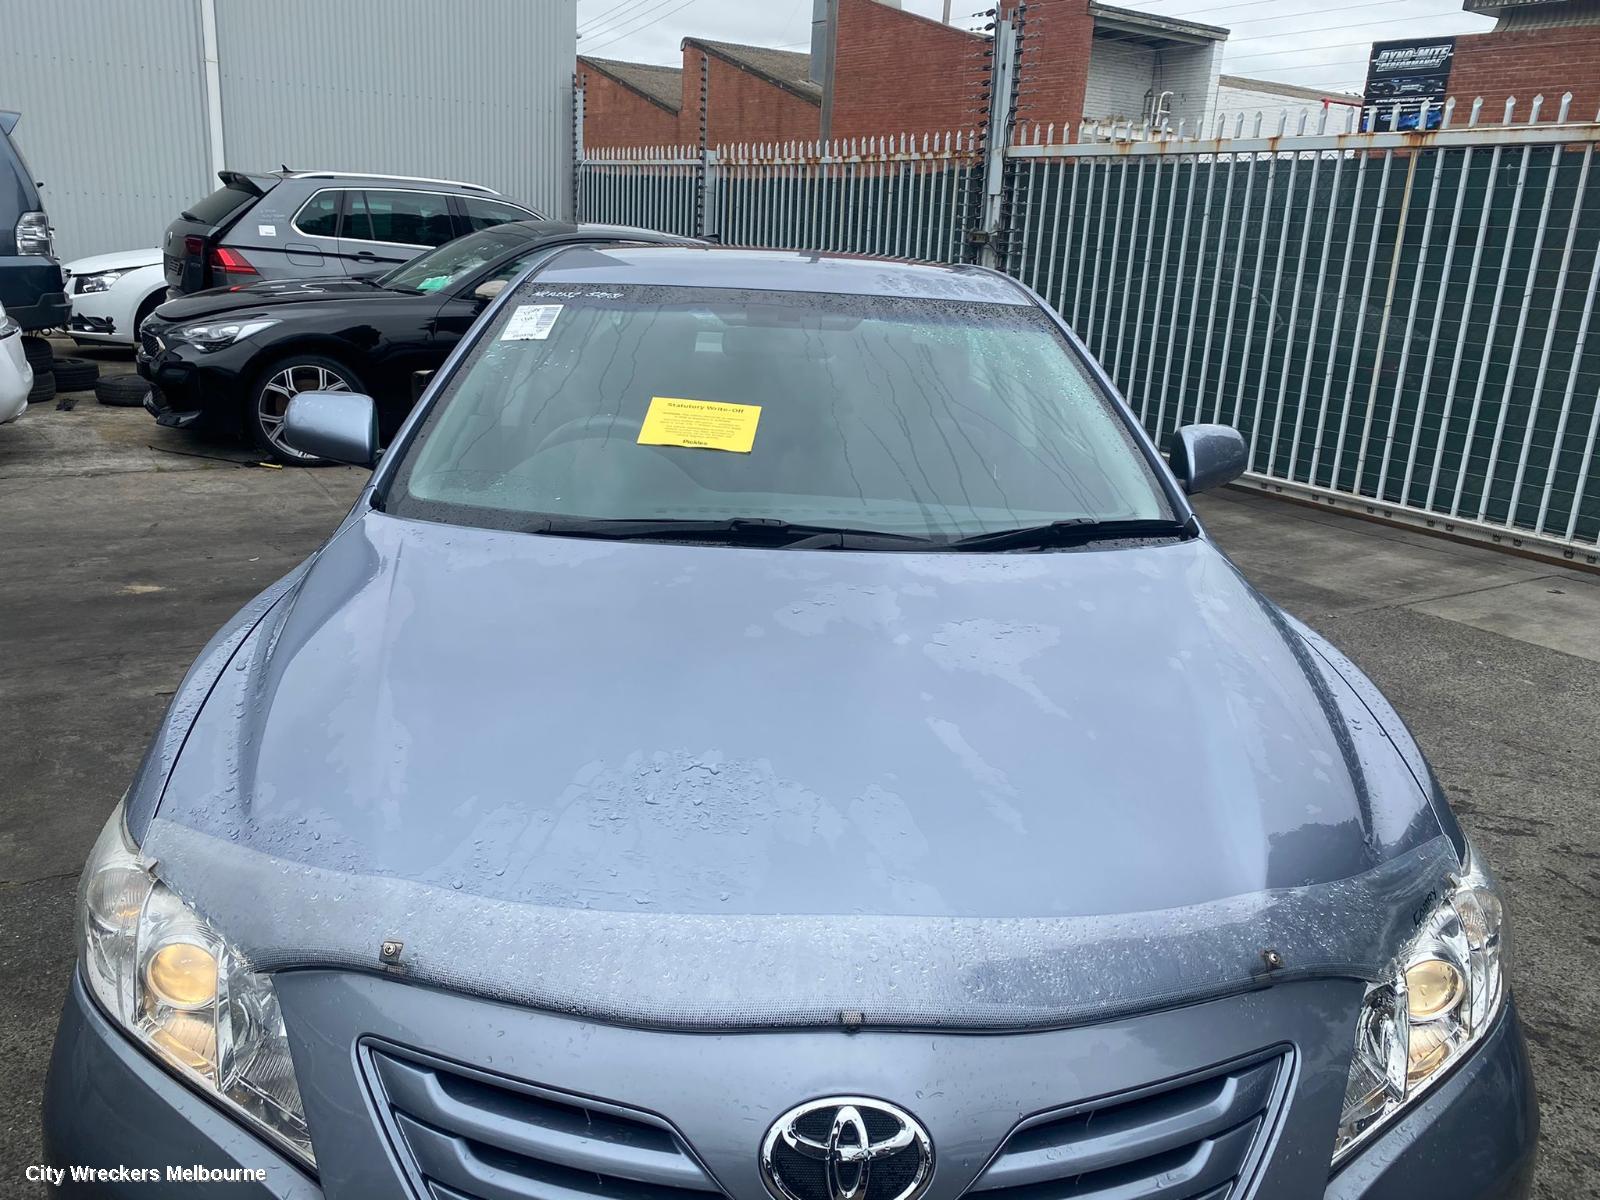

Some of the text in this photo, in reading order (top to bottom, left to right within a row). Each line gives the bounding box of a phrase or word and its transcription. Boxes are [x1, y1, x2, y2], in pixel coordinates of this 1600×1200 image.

[1381, 47, 1448, 61] DYNO-MITE
[1381, 59, 1441, 69] PERFORMANCE
[667, 402, 745, 414] Statutory Write-Off
[1413, 887, 1437, 925] CAMRY
